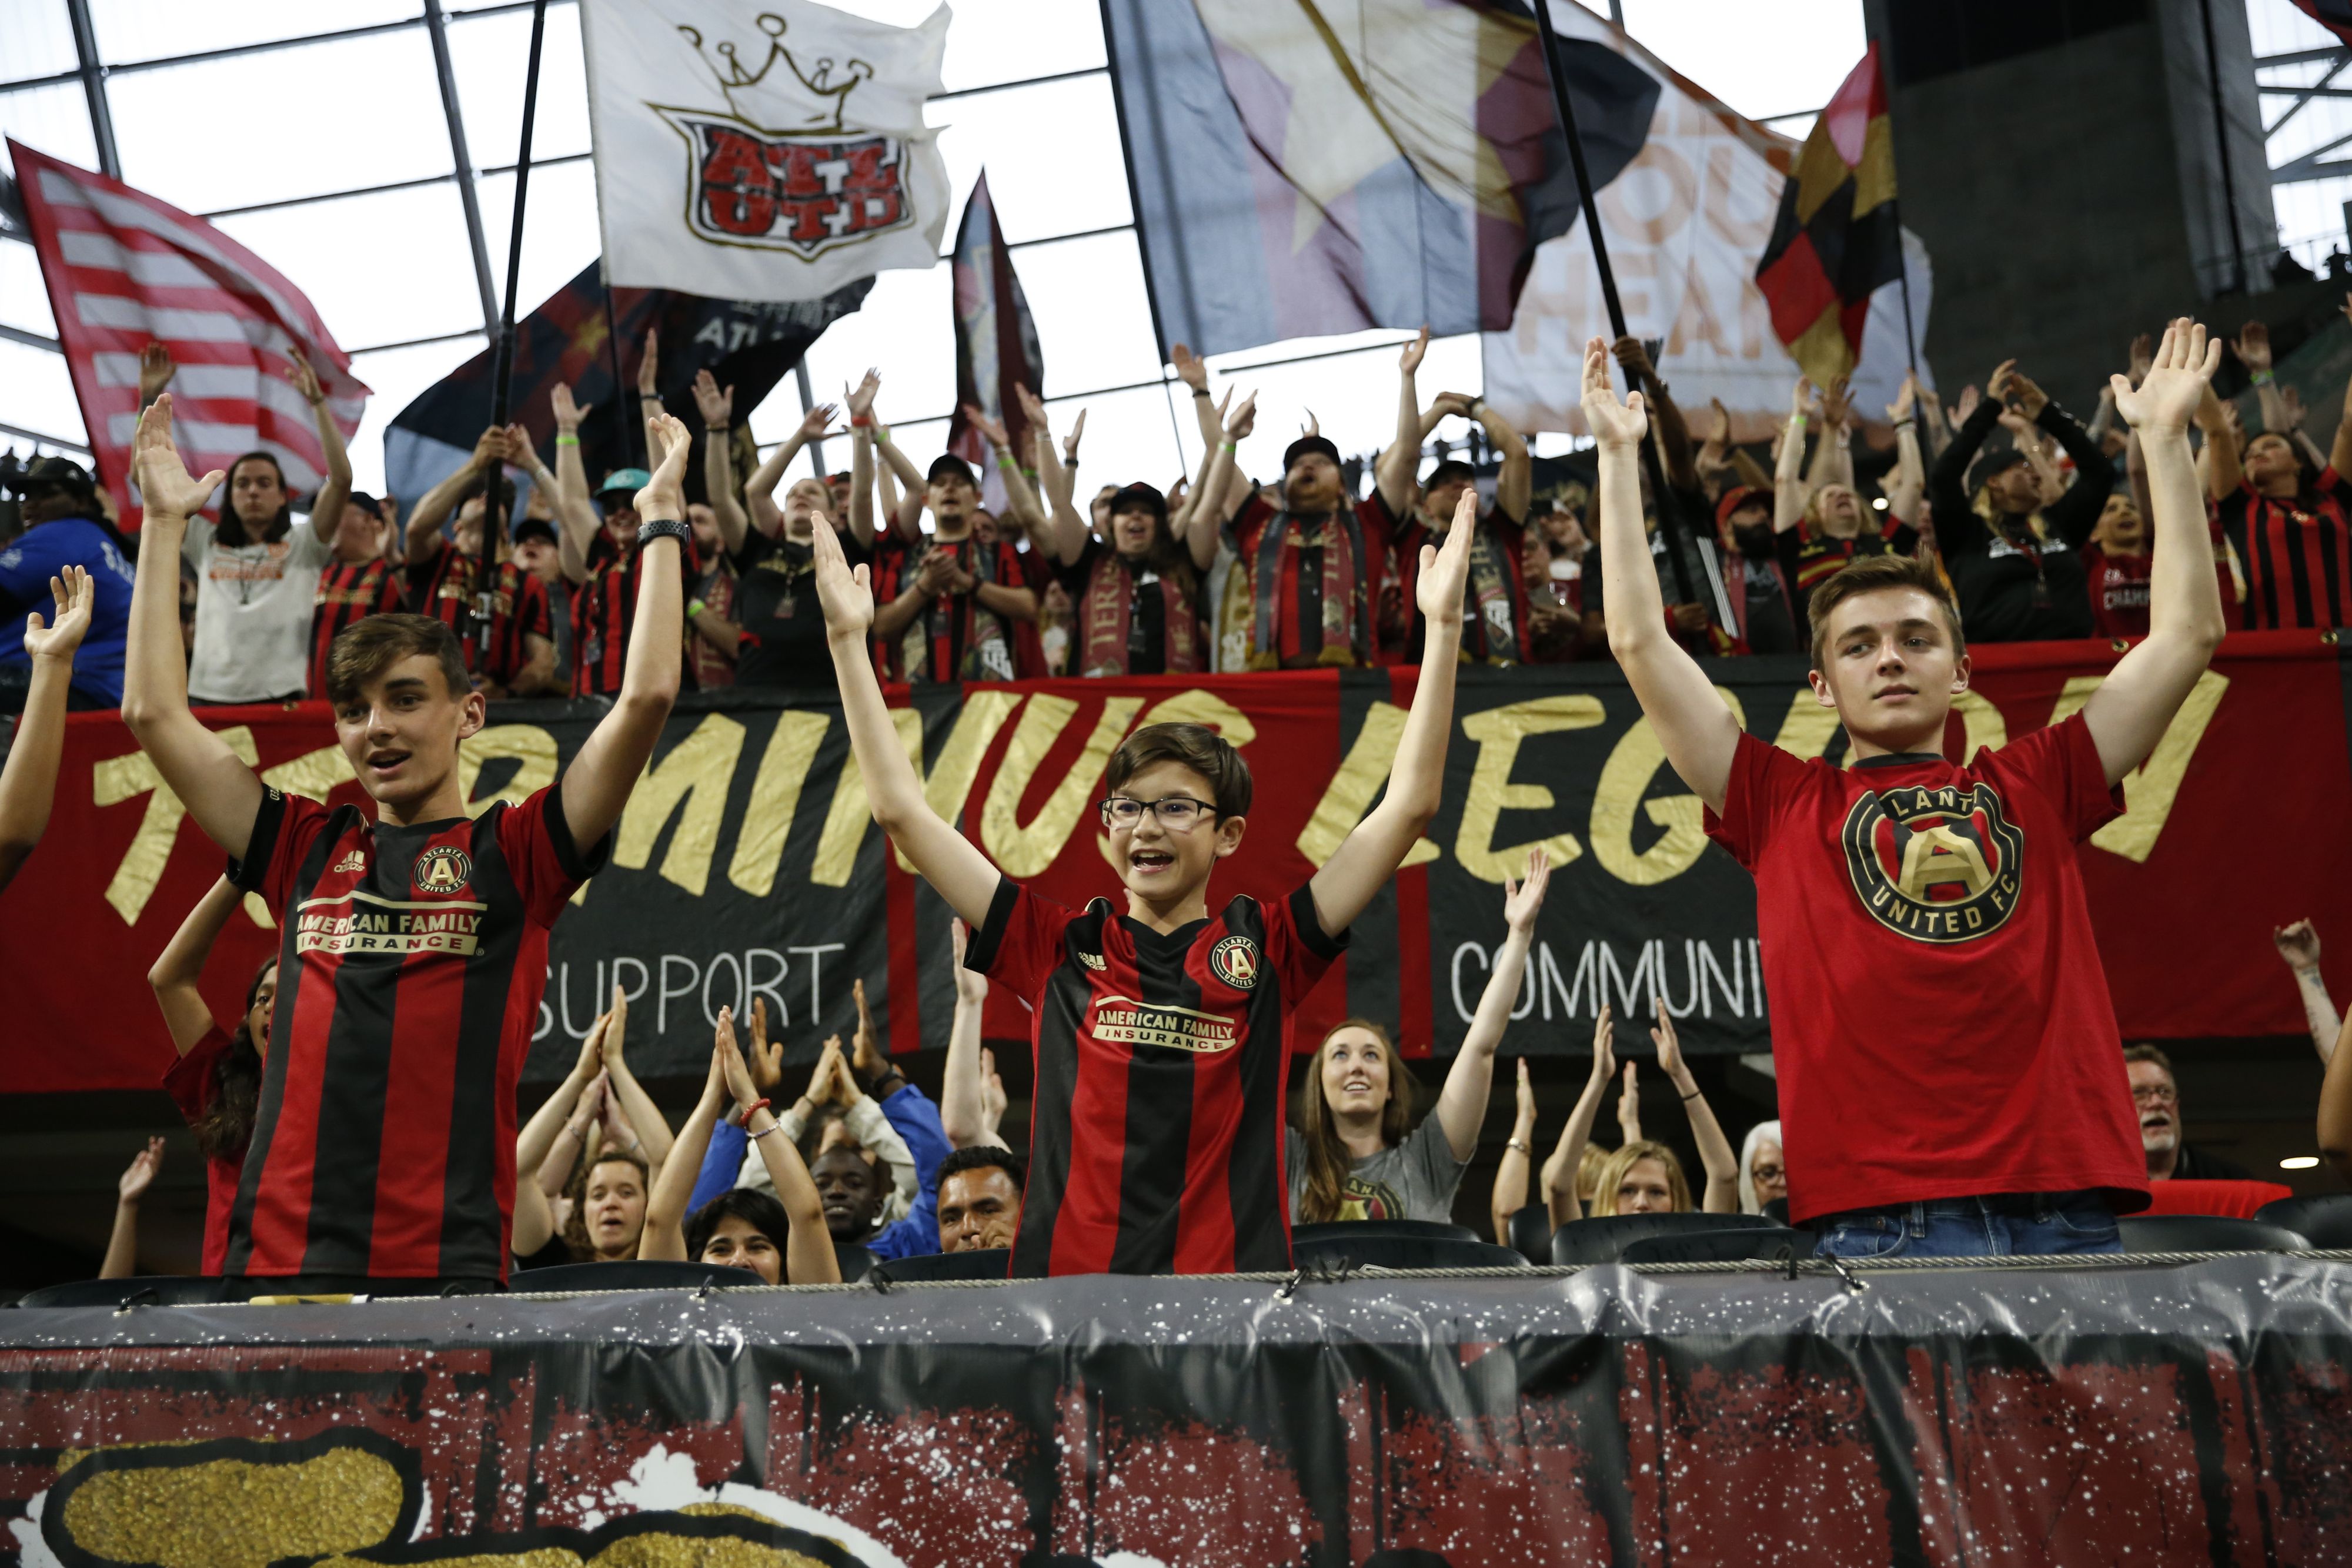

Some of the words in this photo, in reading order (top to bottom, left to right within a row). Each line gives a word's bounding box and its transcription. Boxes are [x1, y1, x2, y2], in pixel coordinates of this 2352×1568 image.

[703, 131, 898, 193] ATL
[1891, 788, 1979, 818] LANT
[423, 847, 463, 864] ATLANTA
[333, 861, 366, 874] adidas
[420, 882, 452, 892] UNITED
[454, 878, 466, 891] FC
[1872, 885, 1982, 934] UNITED
[1990, 874, 2016, 911] FC
[297, 913, 389, 934] AMERICAN
[399, 914, 482, 934] FAMILY
[301, 936, 463, 950] INSURANCE
[1217, 938, 1252, 954] ATLANTA
[1078, 952, 1108, 972] adidas
[1225, 974, 1252, 985] UNITED
[1451, 938, 1763, 1024] COMMUNI
